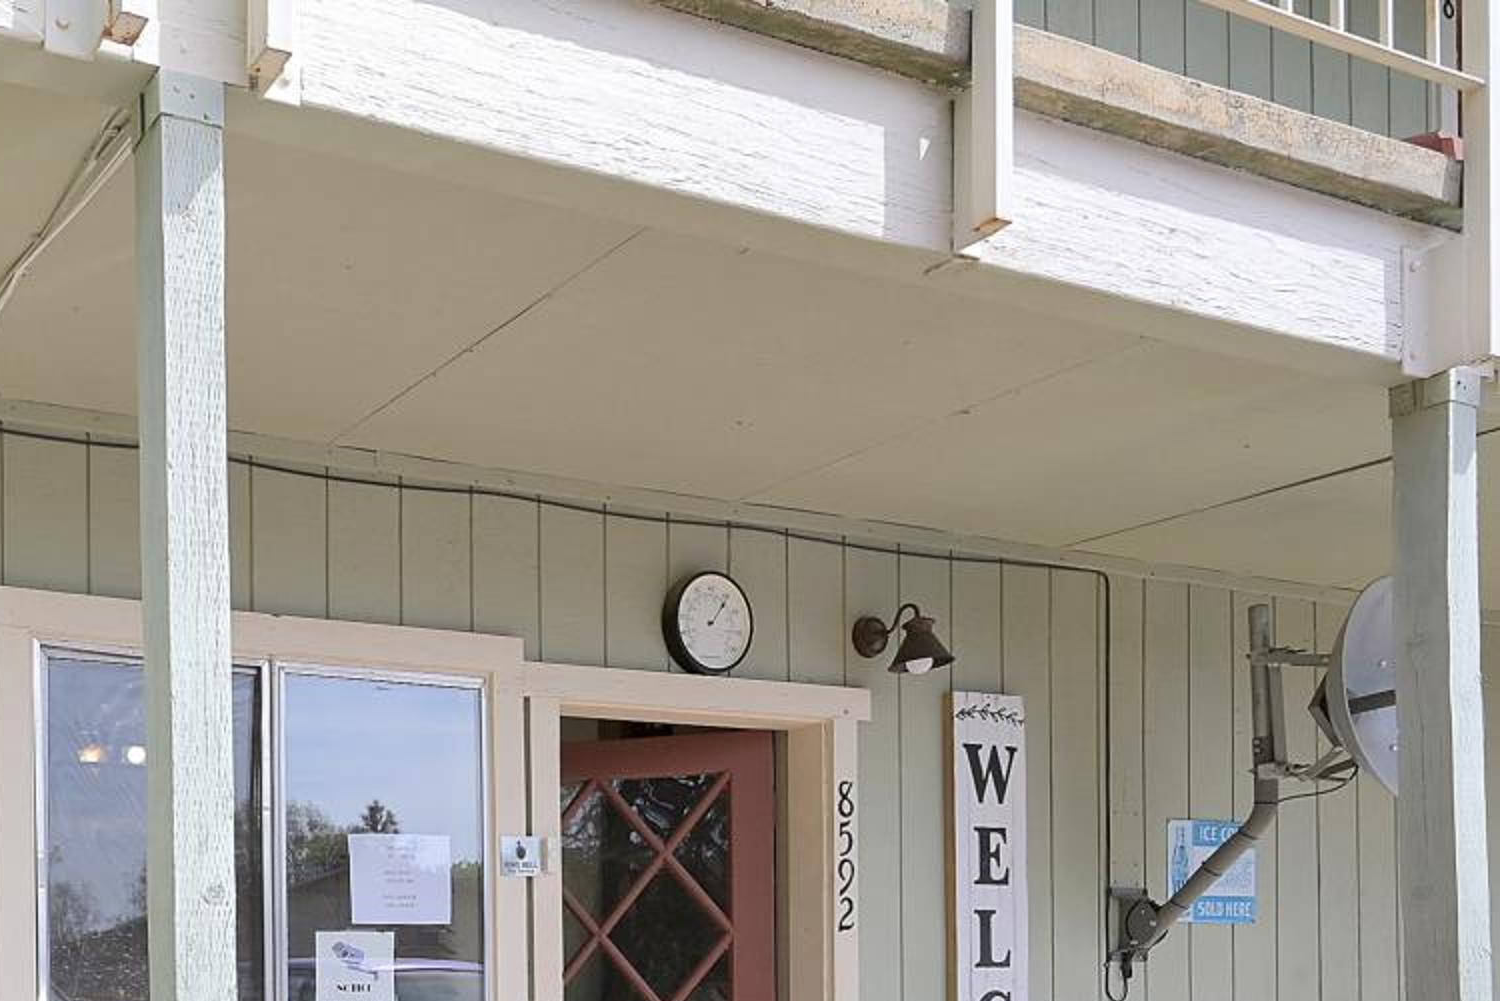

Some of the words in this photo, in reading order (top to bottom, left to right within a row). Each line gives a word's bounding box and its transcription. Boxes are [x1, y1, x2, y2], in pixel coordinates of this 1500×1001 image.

[1199, 826, 1218, 841] ICE
[838, 780, 855, 932] 8592
[1197, 901, 1223, 917] SOLD
[1225, 901, 1252, 917] HERE
